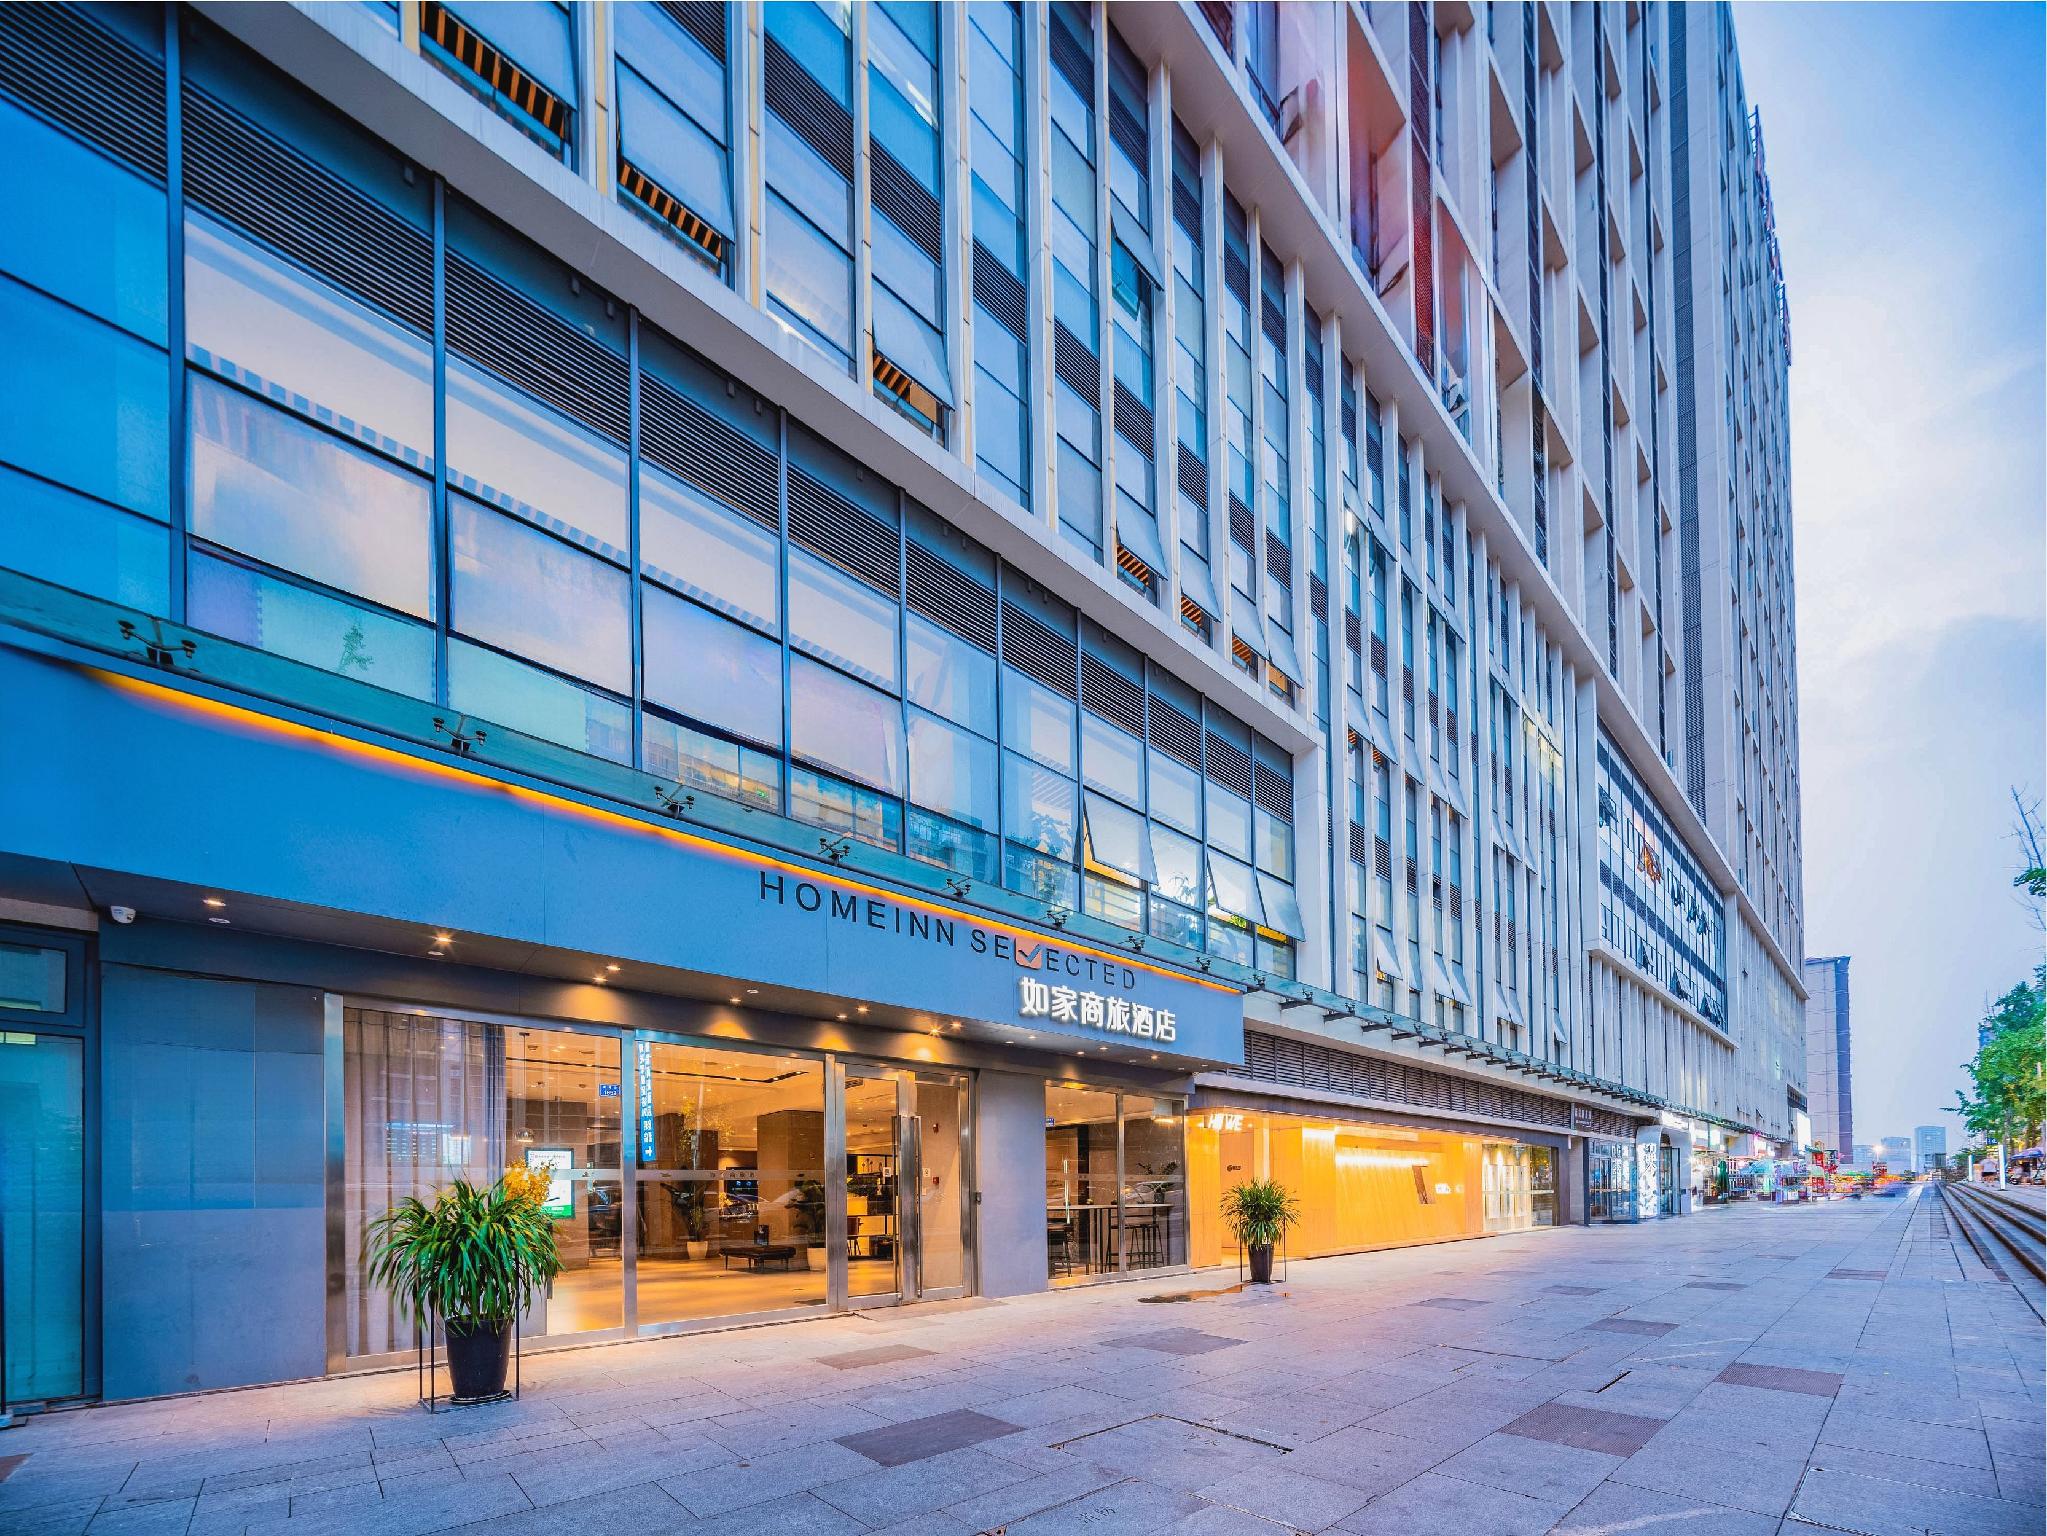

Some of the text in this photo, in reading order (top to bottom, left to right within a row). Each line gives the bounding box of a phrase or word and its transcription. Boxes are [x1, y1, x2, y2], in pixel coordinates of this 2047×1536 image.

[760, 871, 953, 946] HOMEINN
[1021, 976, 1176, 1042] 如家商旅酒店
